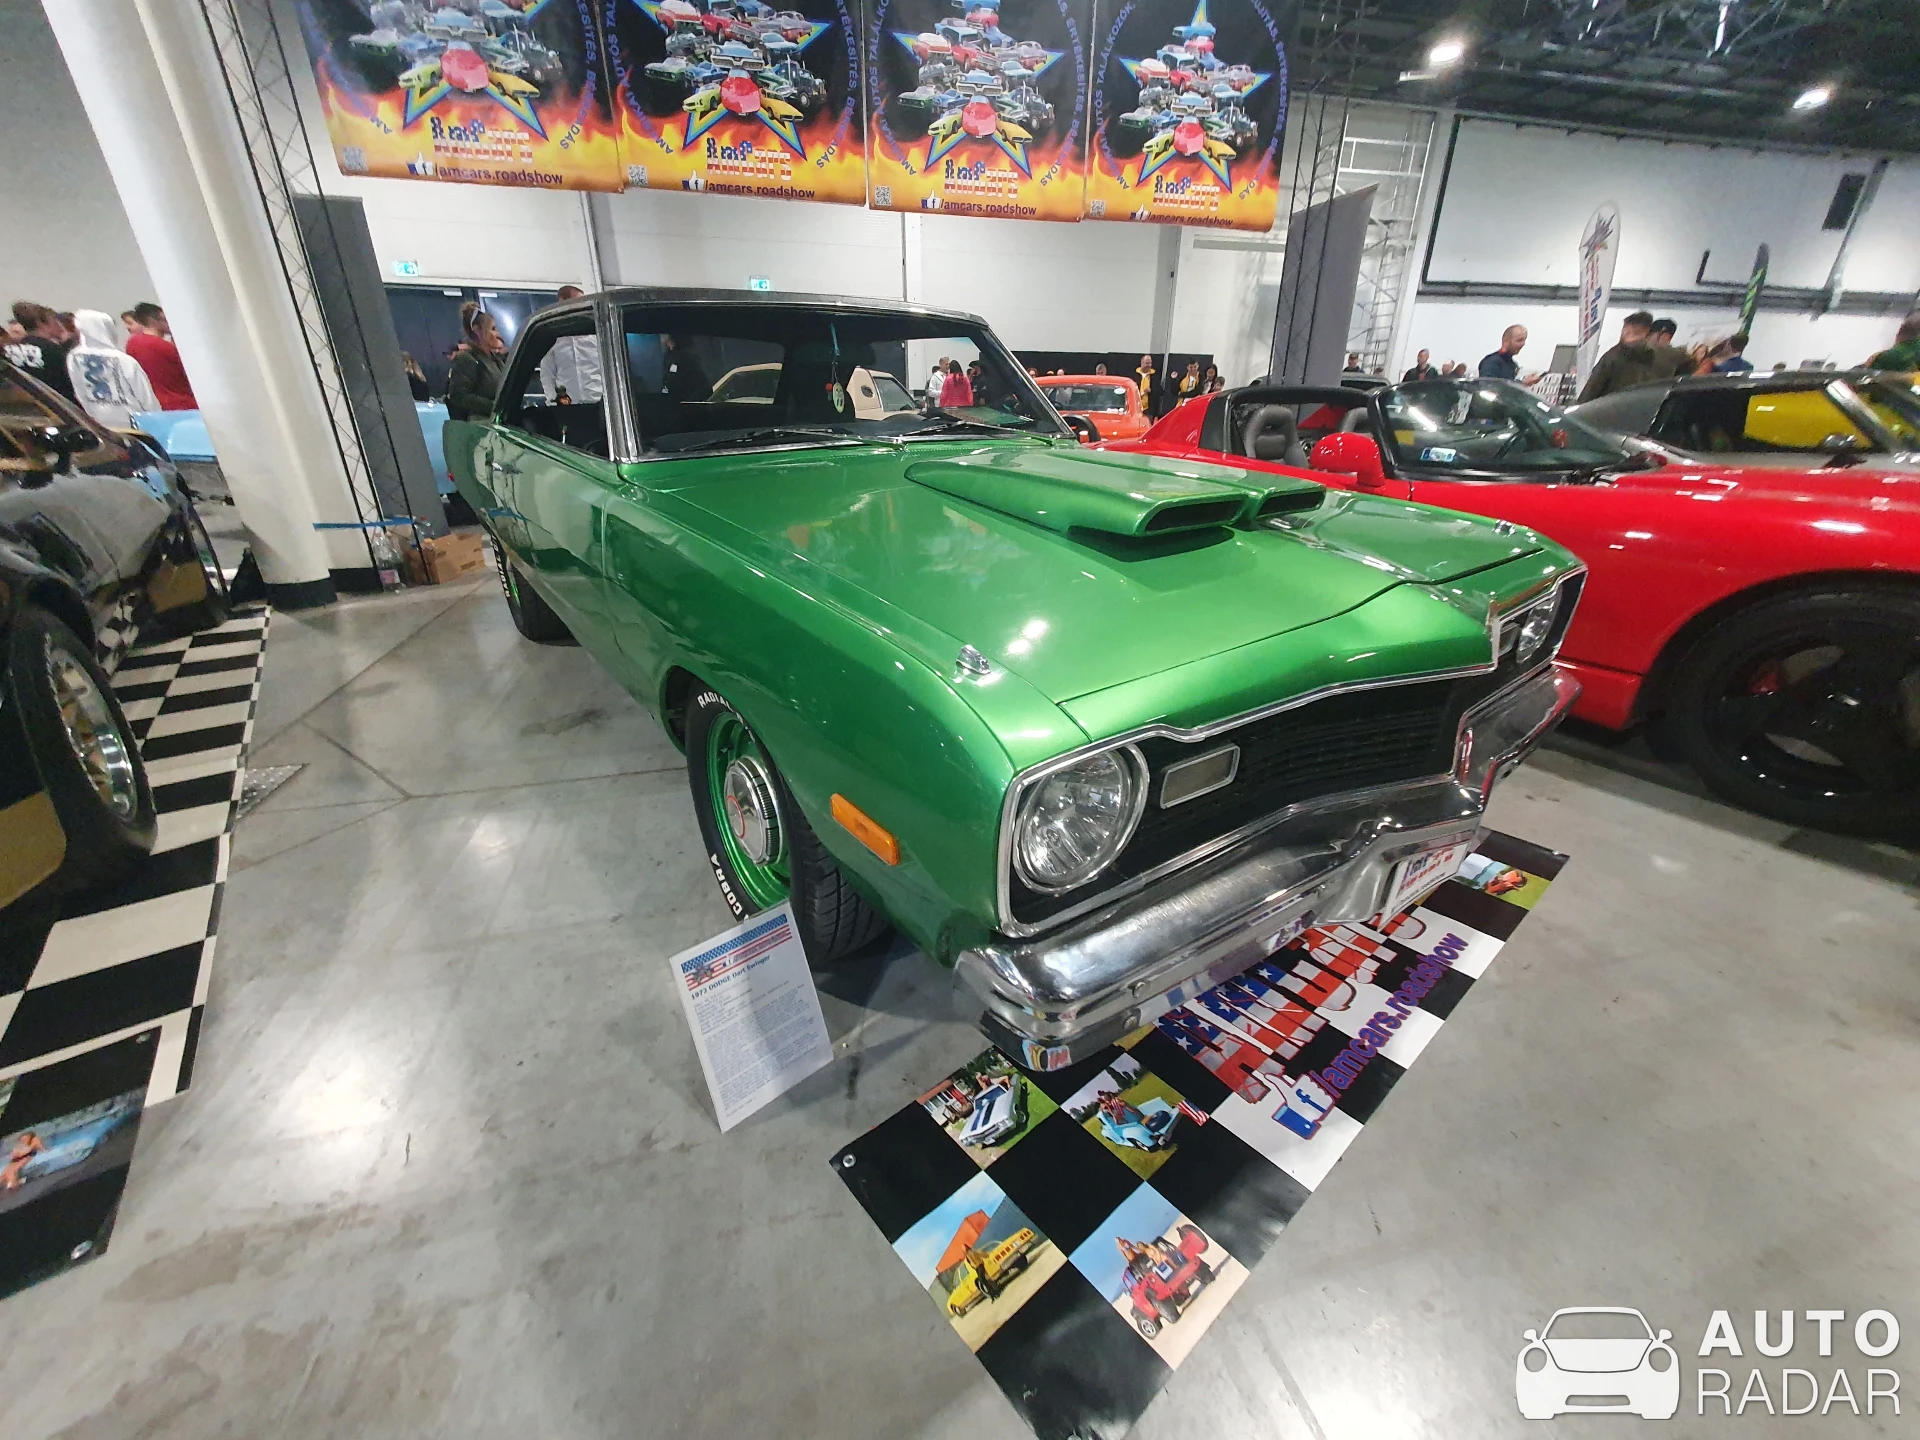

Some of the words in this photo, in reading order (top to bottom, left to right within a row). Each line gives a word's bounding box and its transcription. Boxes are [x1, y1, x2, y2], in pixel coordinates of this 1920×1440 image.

[710, 853, 743, 915] COBRA
[708, 975, 731, 991] DODGE
[1311, 932, 1469, 1100] /amcars.roadshow
